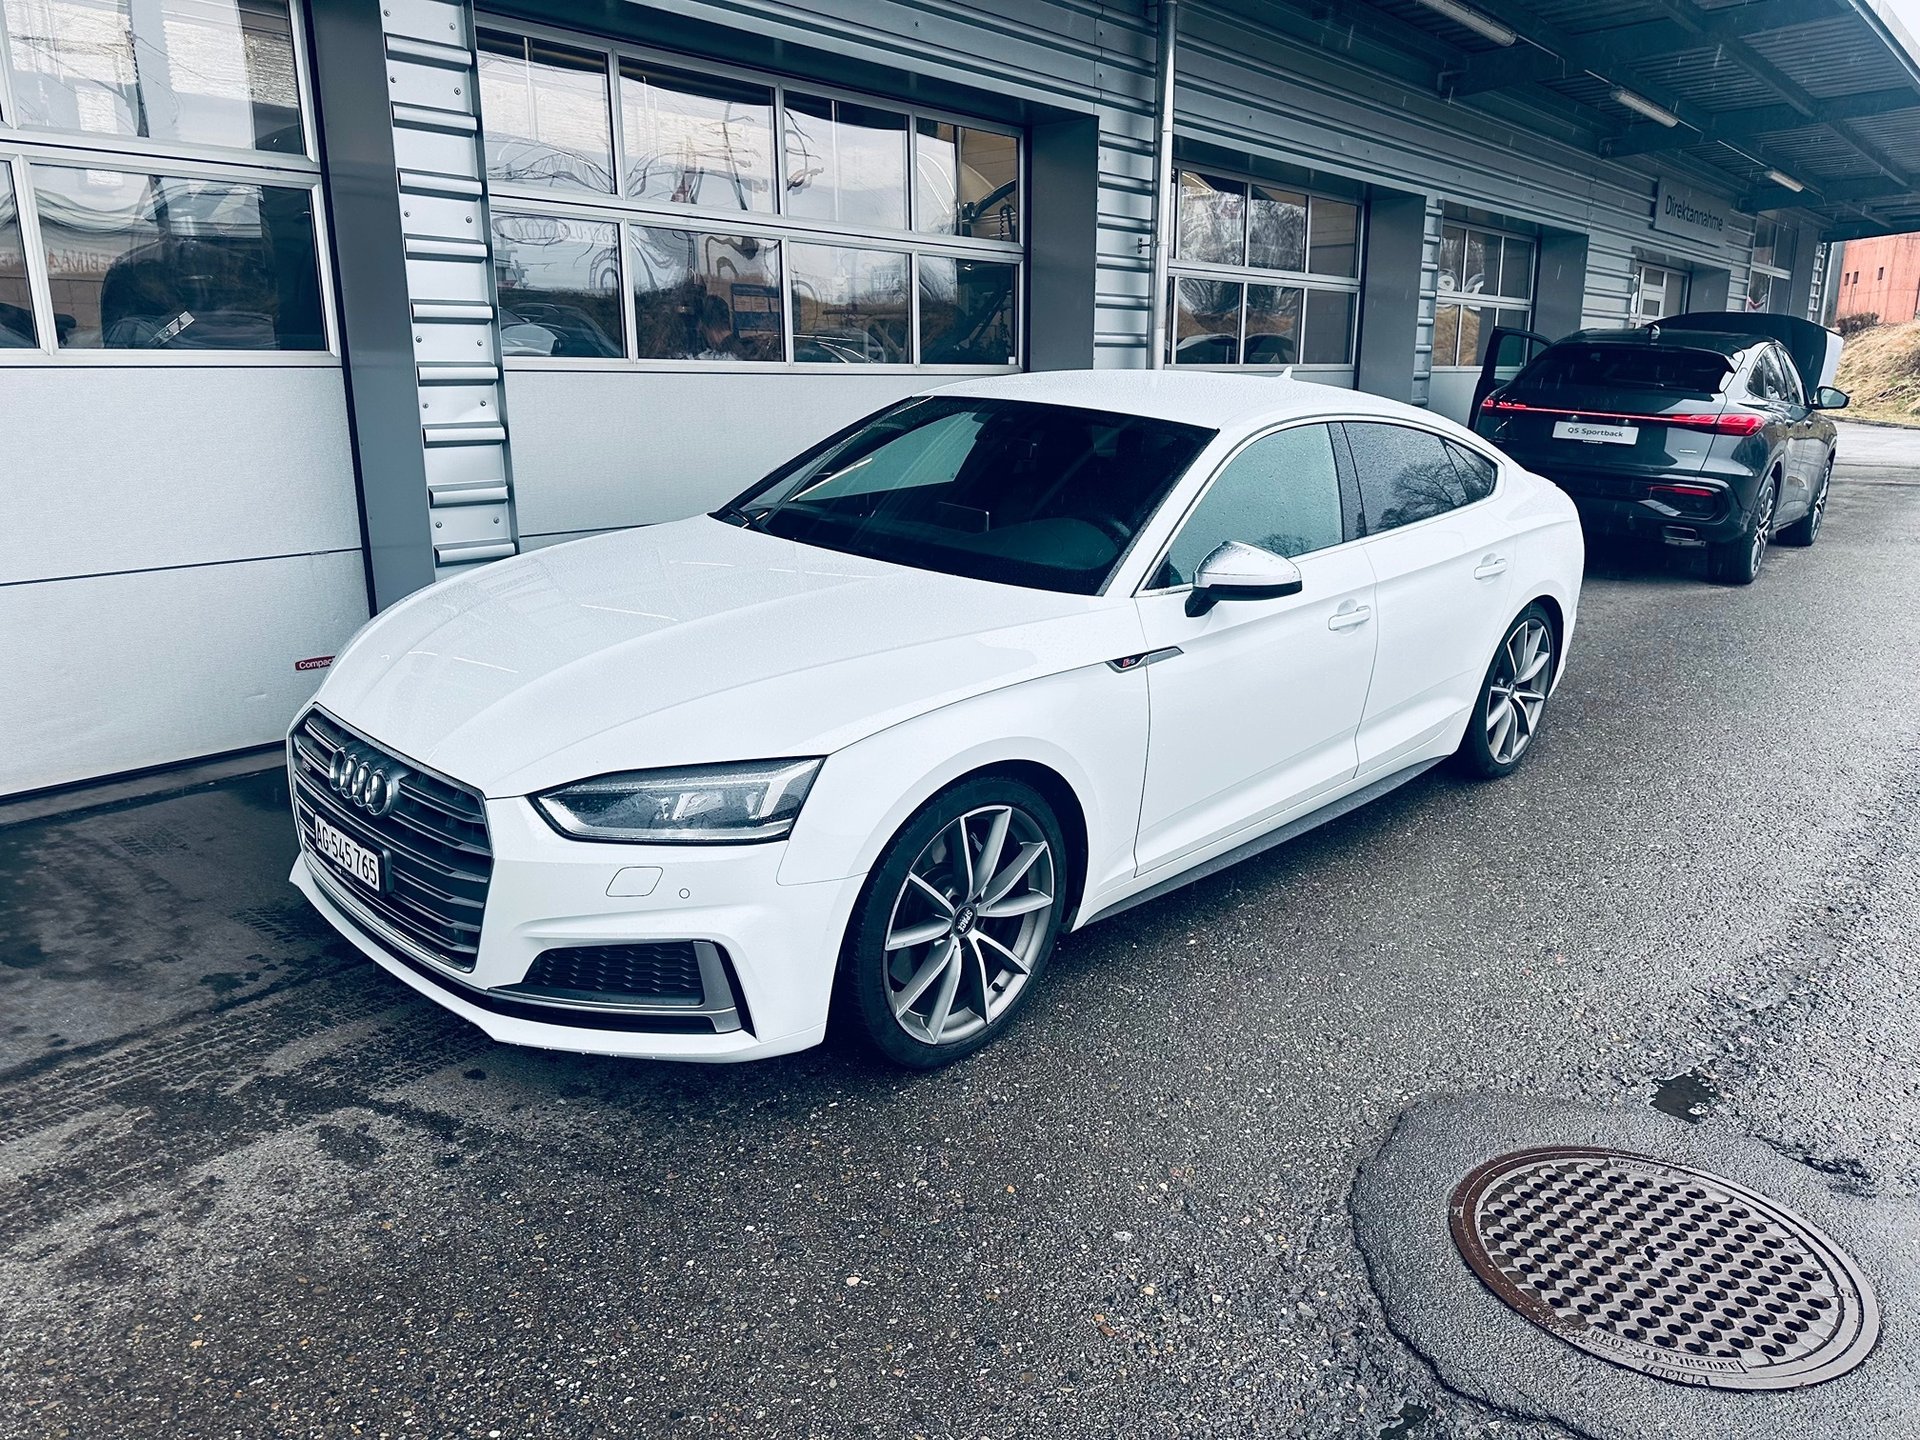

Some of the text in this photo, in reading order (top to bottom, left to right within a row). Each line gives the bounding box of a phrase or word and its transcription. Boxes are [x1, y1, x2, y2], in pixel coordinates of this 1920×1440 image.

[1665, 195, 1724, 232] Direktannahme
[1567, 427, 1624, 438] Q5 Sportback
[298, 658, 333, 670] Compac
[957, 909, 974, 934] SPACE
